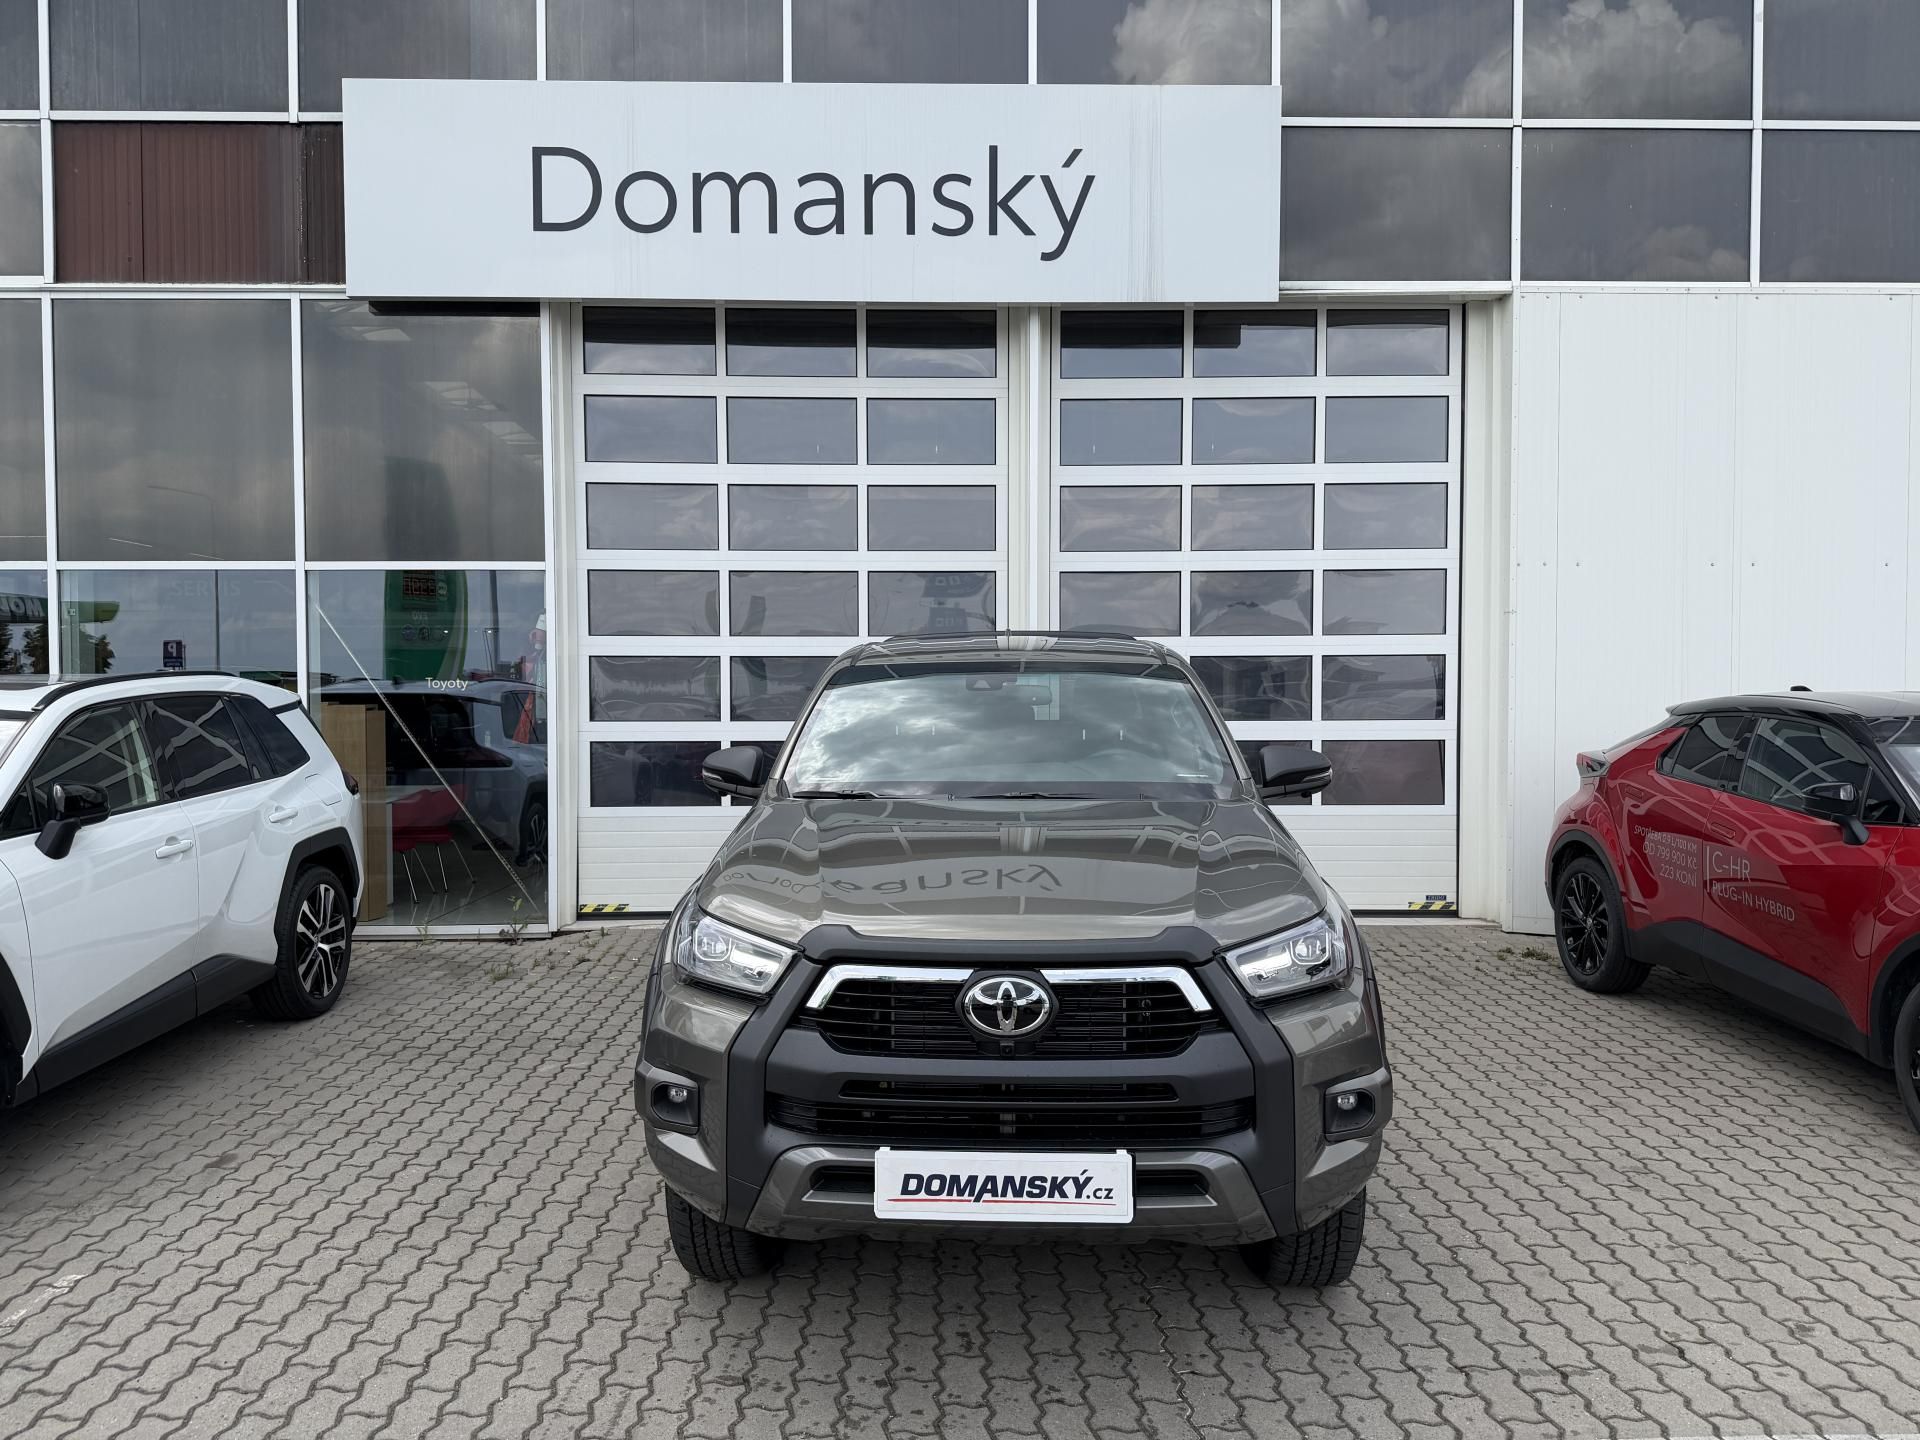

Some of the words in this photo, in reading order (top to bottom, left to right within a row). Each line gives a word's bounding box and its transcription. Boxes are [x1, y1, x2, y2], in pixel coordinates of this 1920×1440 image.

[532, 145, 1095, 261] Domanský
[425, 678, 468, 691] Toyoty
[1643, 841, 1655, 855] OD
[1656, 846, 1670, 860] 799
[1687, 840, 1697, 853] KM
[1659, 864, 1674, 879] 223
[1712, 851, 1751, 883] C-HR
[1712, 880, 1753, 907] PLUG-IN
[1755, 895, 1795, 922] HYBRID
